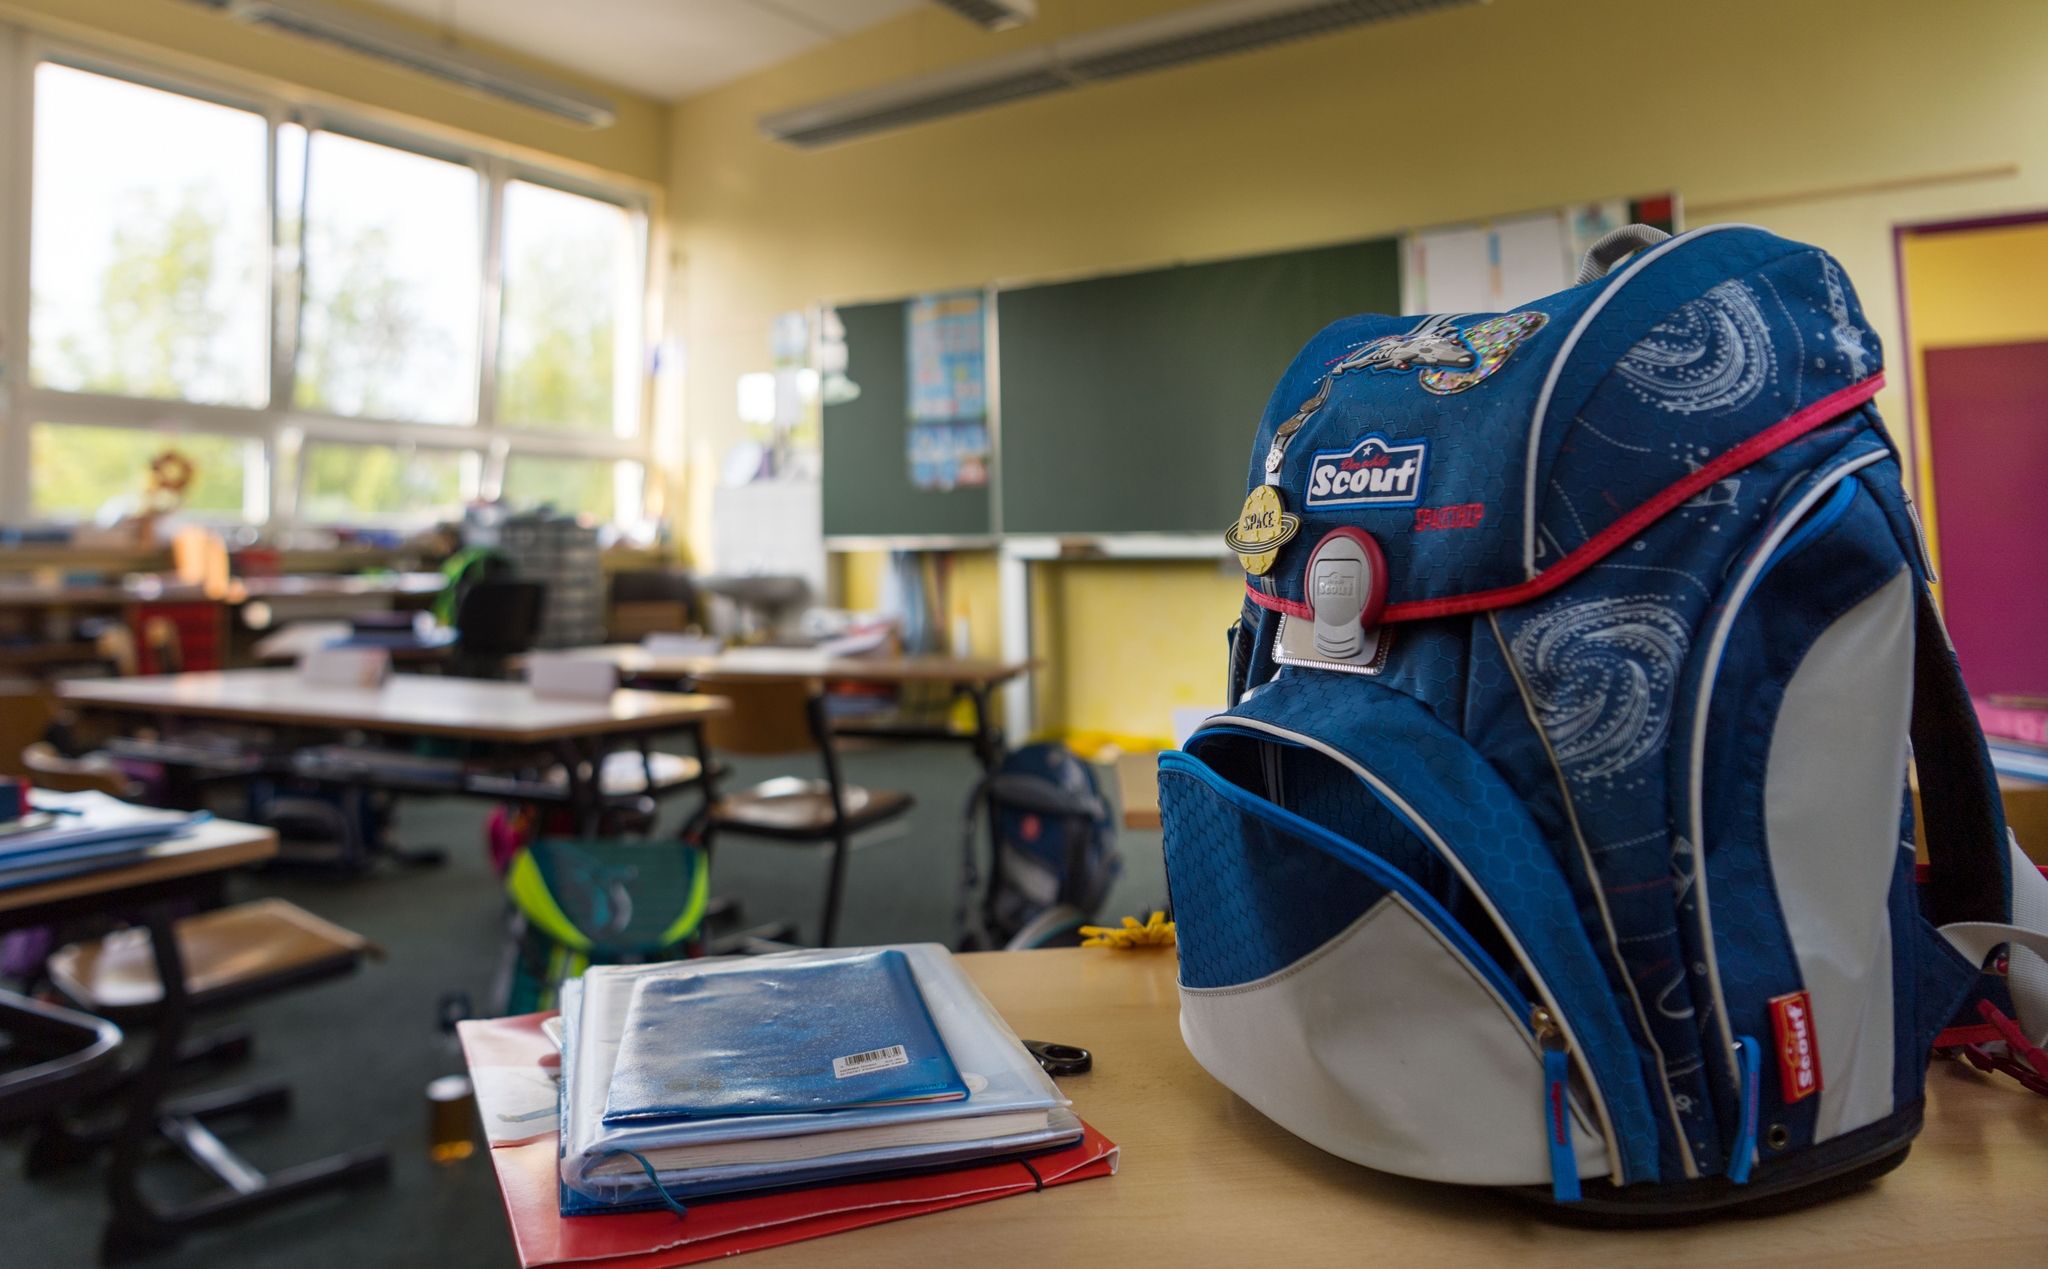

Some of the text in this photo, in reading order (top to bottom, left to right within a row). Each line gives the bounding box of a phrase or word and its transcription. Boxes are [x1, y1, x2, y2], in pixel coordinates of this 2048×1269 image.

[1311, 459, 1415, 496] Scout
[1243, 511, 1275, 530] SPACE
[1787, 1005, 1812, 1087] Scout
